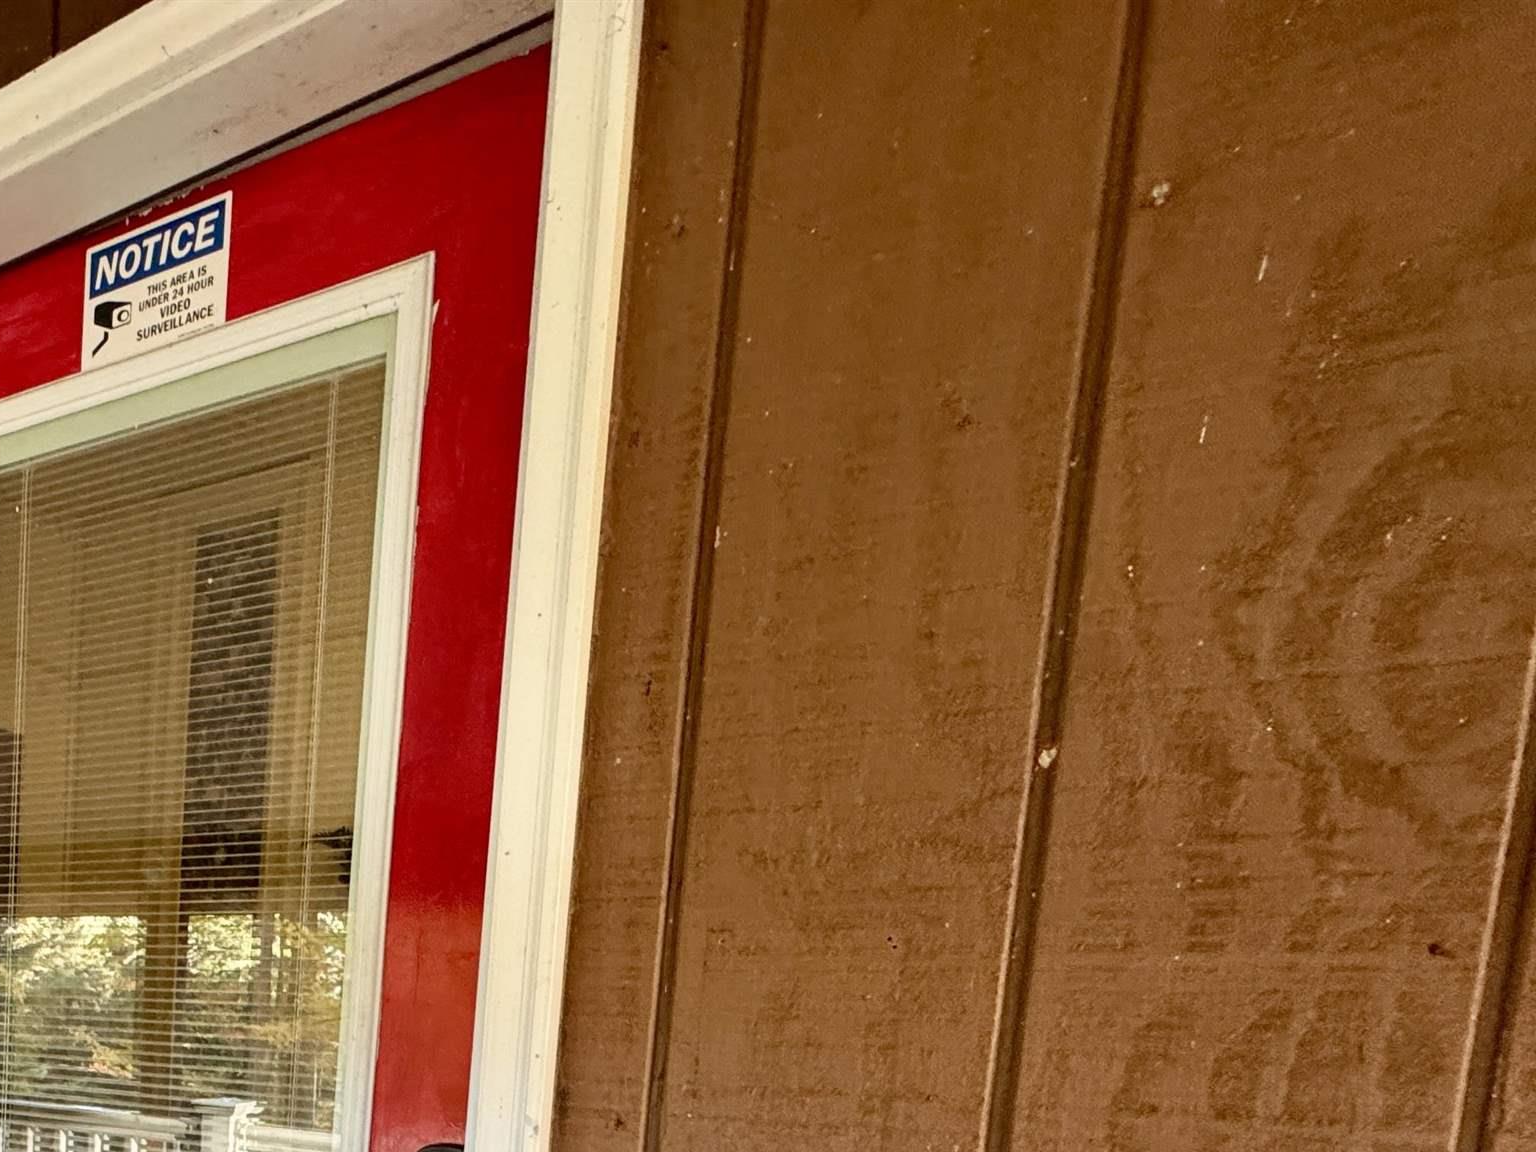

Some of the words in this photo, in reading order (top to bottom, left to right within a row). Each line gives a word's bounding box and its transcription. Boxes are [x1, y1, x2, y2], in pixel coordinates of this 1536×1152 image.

[94, 209, 220, 291] NOTICE
[138, 292, 170, 312] UNDER
[172, 286, 184, 300] 24
[187, 275, 214, 295] HOUR
[147, 280, 168, 297] THIS
[170, 270, 195, 289] AREA
[197, 264, 207, 278] IS
[135, 303, 214, 342] SURVEILLANCE
[159, 297, 191, 319] VIDEO
